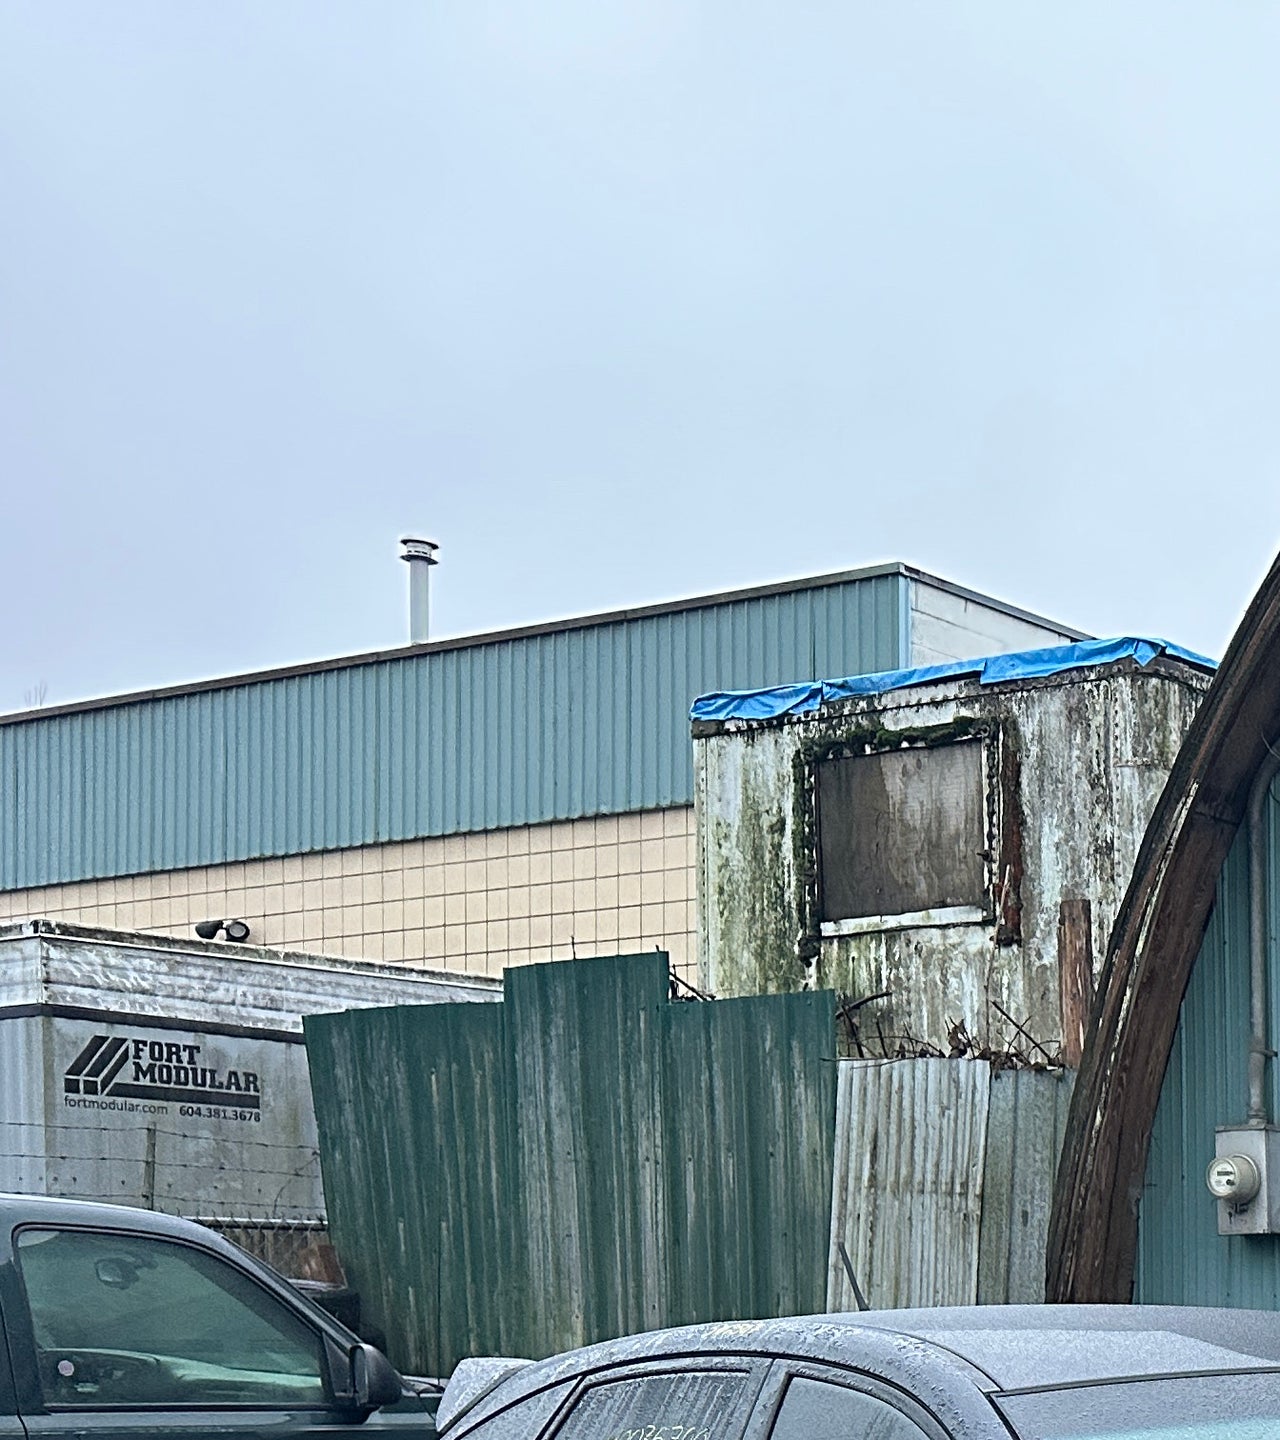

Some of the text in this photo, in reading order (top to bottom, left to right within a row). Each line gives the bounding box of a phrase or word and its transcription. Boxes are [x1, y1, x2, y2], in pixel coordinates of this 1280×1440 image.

[131, 1038, 201, 1066] FORT
[131, 1061, 261, 1093] MODULAR
[64, 1095, 262, 1123] fortmodular.com 604.381.3678
